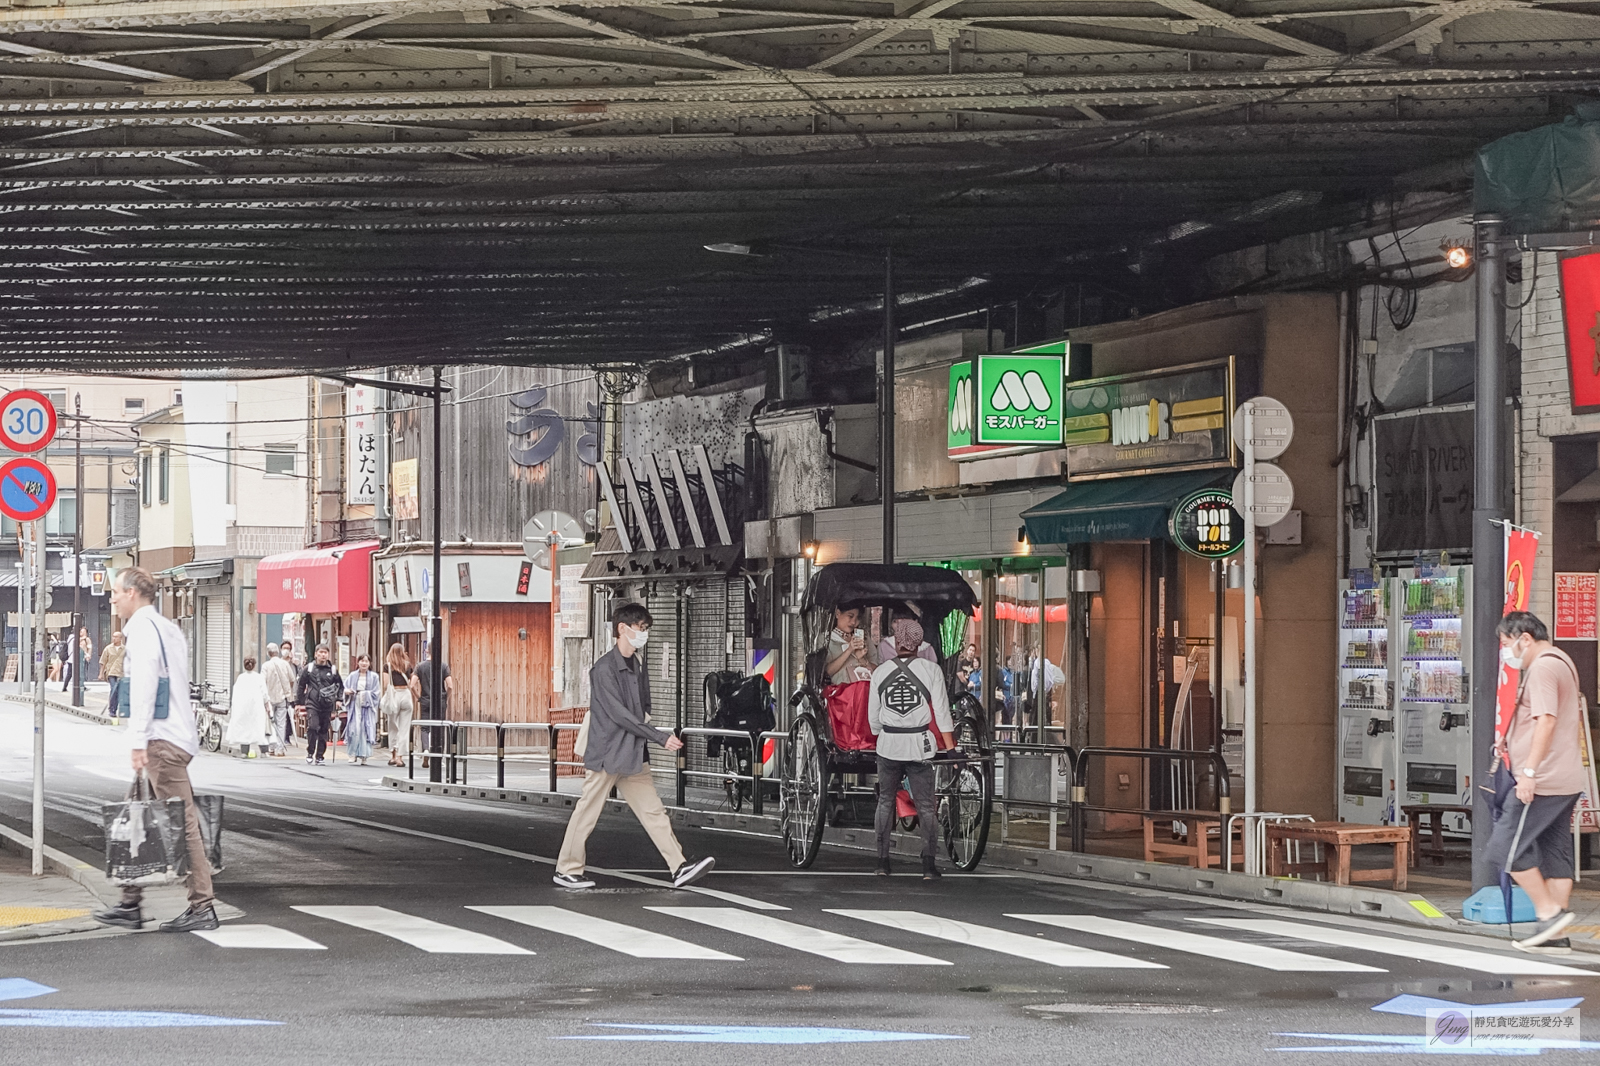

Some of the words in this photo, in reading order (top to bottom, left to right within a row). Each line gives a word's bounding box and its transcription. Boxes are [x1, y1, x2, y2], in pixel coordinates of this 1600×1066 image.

[8, 407, 44, 435] 30
[985, 415, 1058, 430] モスバーガー
[1428, 446, 1468, 473] RIVER
[1185, 495, 1215, 513] GOURMET
[1198, 543, 1230, 551] ドトールコーヒー
